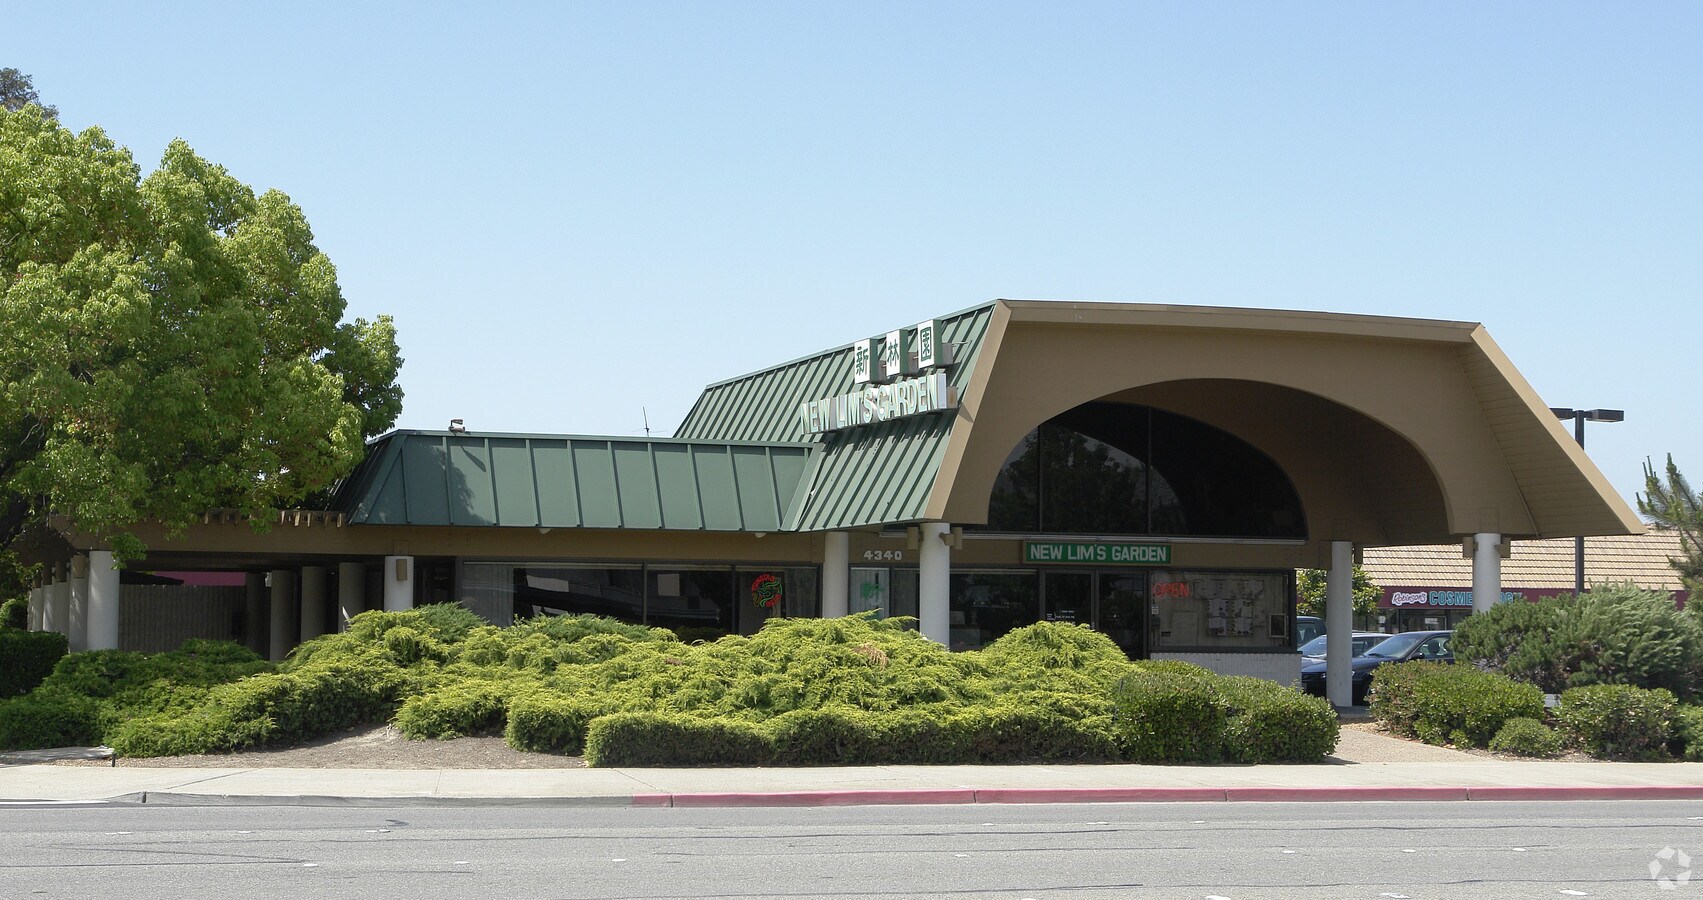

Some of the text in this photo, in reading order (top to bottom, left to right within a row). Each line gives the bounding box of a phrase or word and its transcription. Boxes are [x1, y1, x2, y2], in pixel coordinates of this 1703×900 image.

[800, 373, 938, 435] NEW LIM'S GARDEN
[863, 550, 902, 560] 4340
[1030, 544, 1167, 562] NEW LIM'S GARDEN
[1152, 582, 1191, 598] OPEN
[1429, 591, 1522, 606] COSMEOGY
